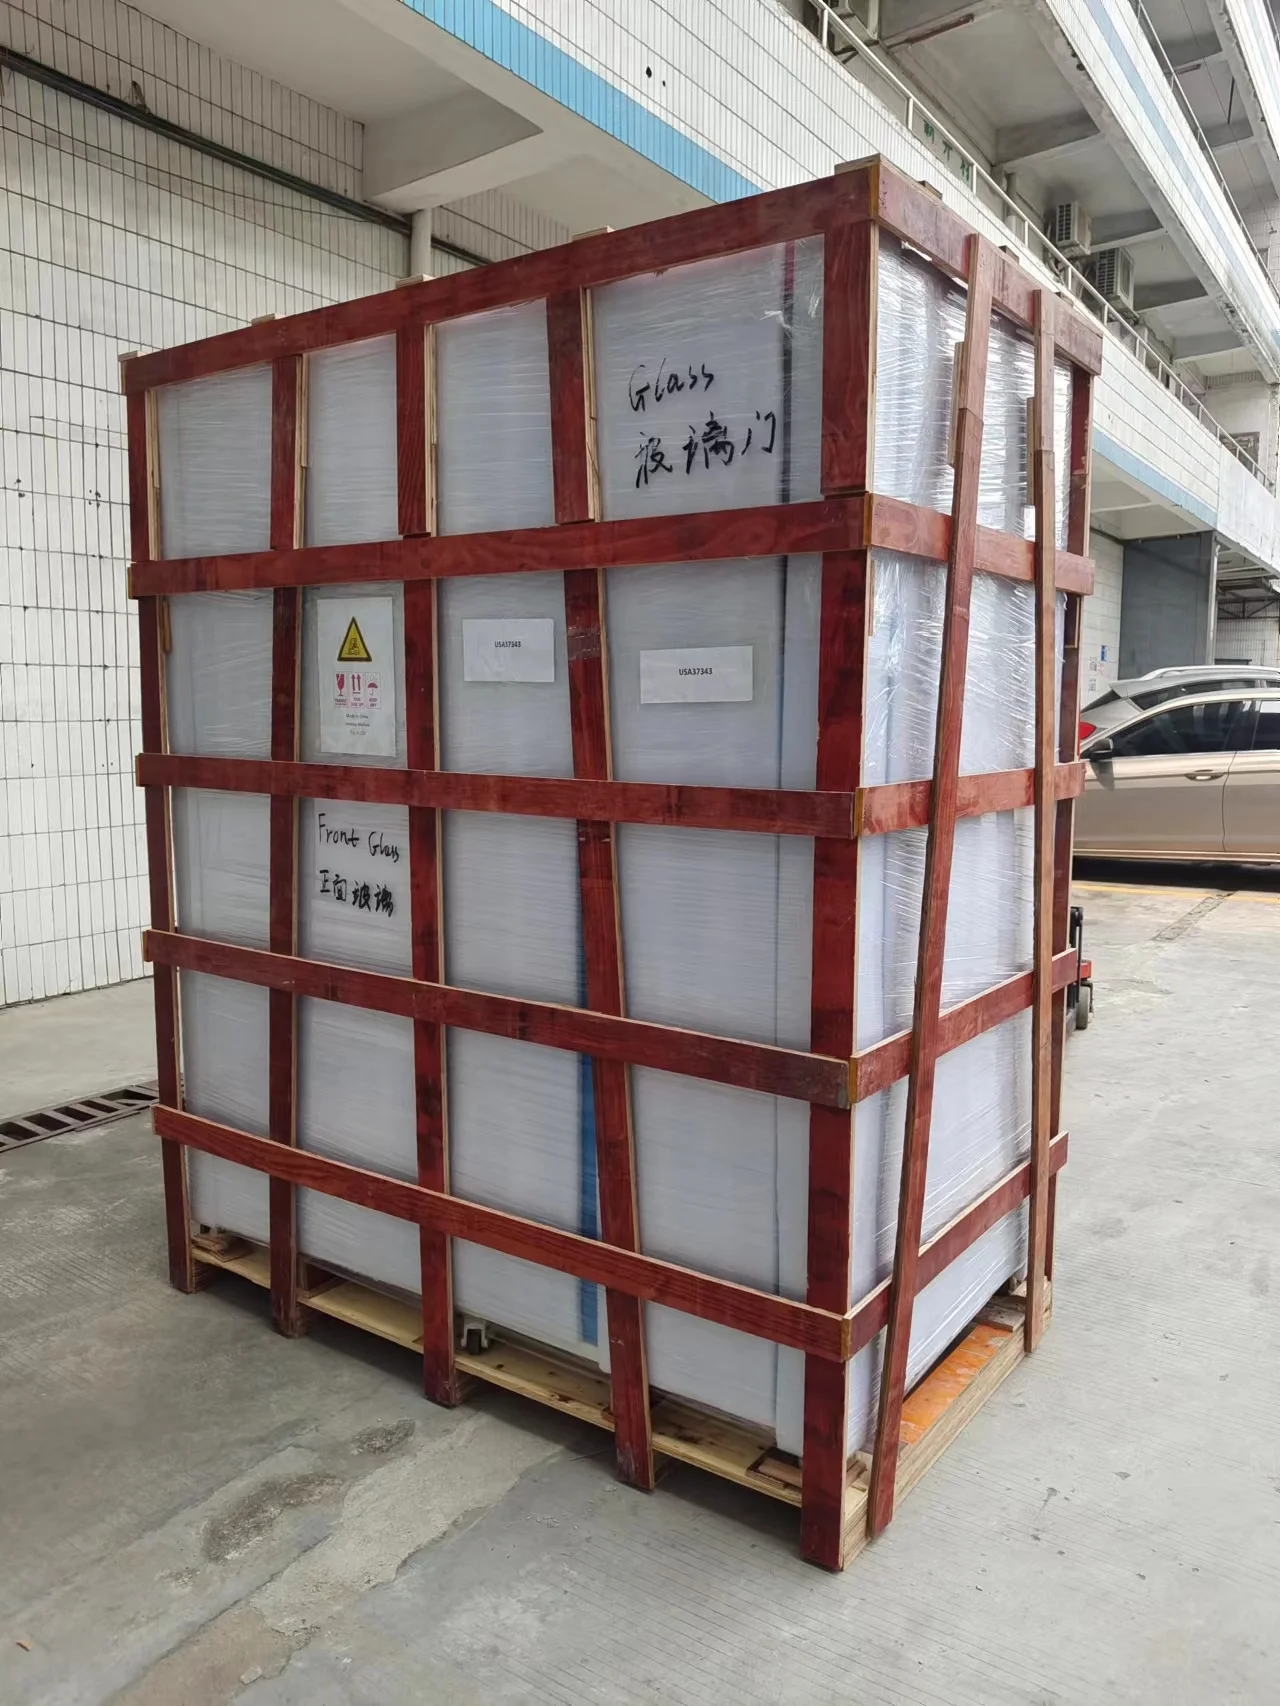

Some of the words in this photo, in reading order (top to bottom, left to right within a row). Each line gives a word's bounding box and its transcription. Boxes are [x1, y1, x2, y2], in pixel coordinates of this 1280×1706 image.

[629, 358, 714, 411] Glass
[494, 641, 521, 649] USA37343
[678, 668, 713, 676] USA37343
[318, 813, 360, 847] Front
